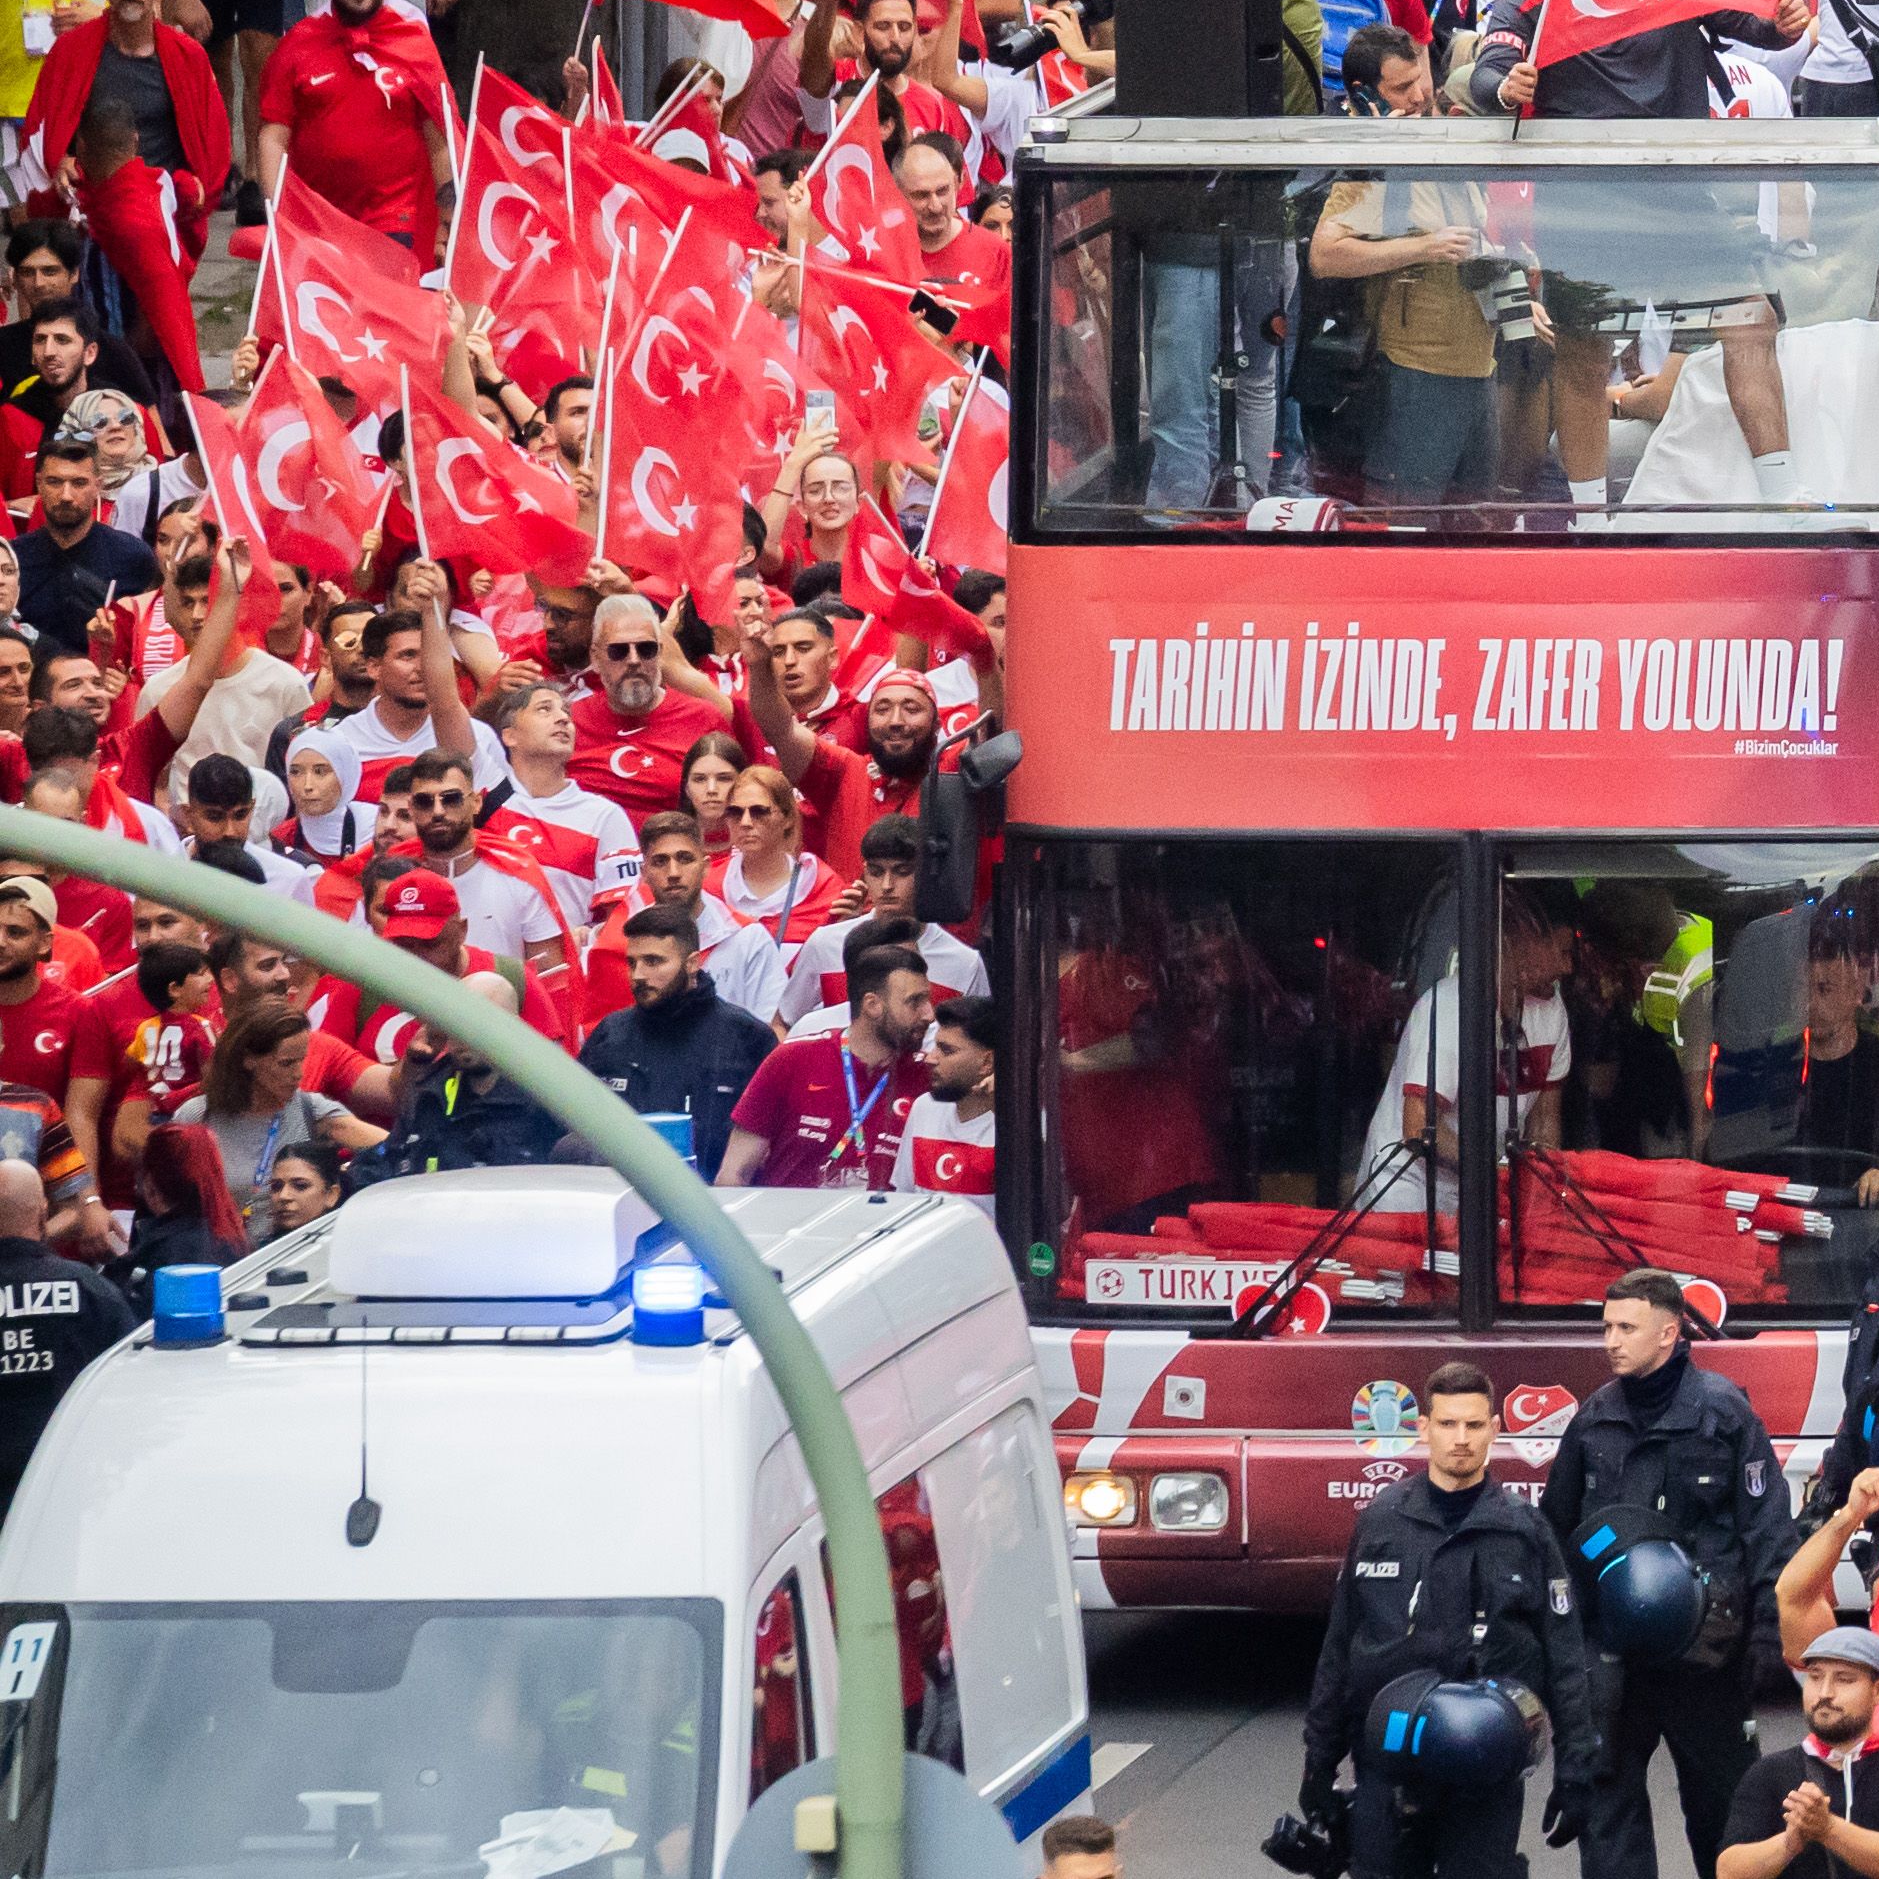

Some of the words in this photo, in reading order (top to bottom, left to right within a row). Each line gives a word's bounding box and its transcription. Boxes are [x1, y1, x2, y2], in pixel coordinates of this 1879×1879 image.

[1109, 621, 1288, 732] TARİHİN
[1298, 621, 1459, 741] İZİNDE,
[1472, 638, 1604, 732] ZAFER
[1616, 638, 1845, 732] YOLUNDA!
[1734, 738, 1839, 759] #BizimÇocuklar
[4, 1327, 35, 1350] BE
